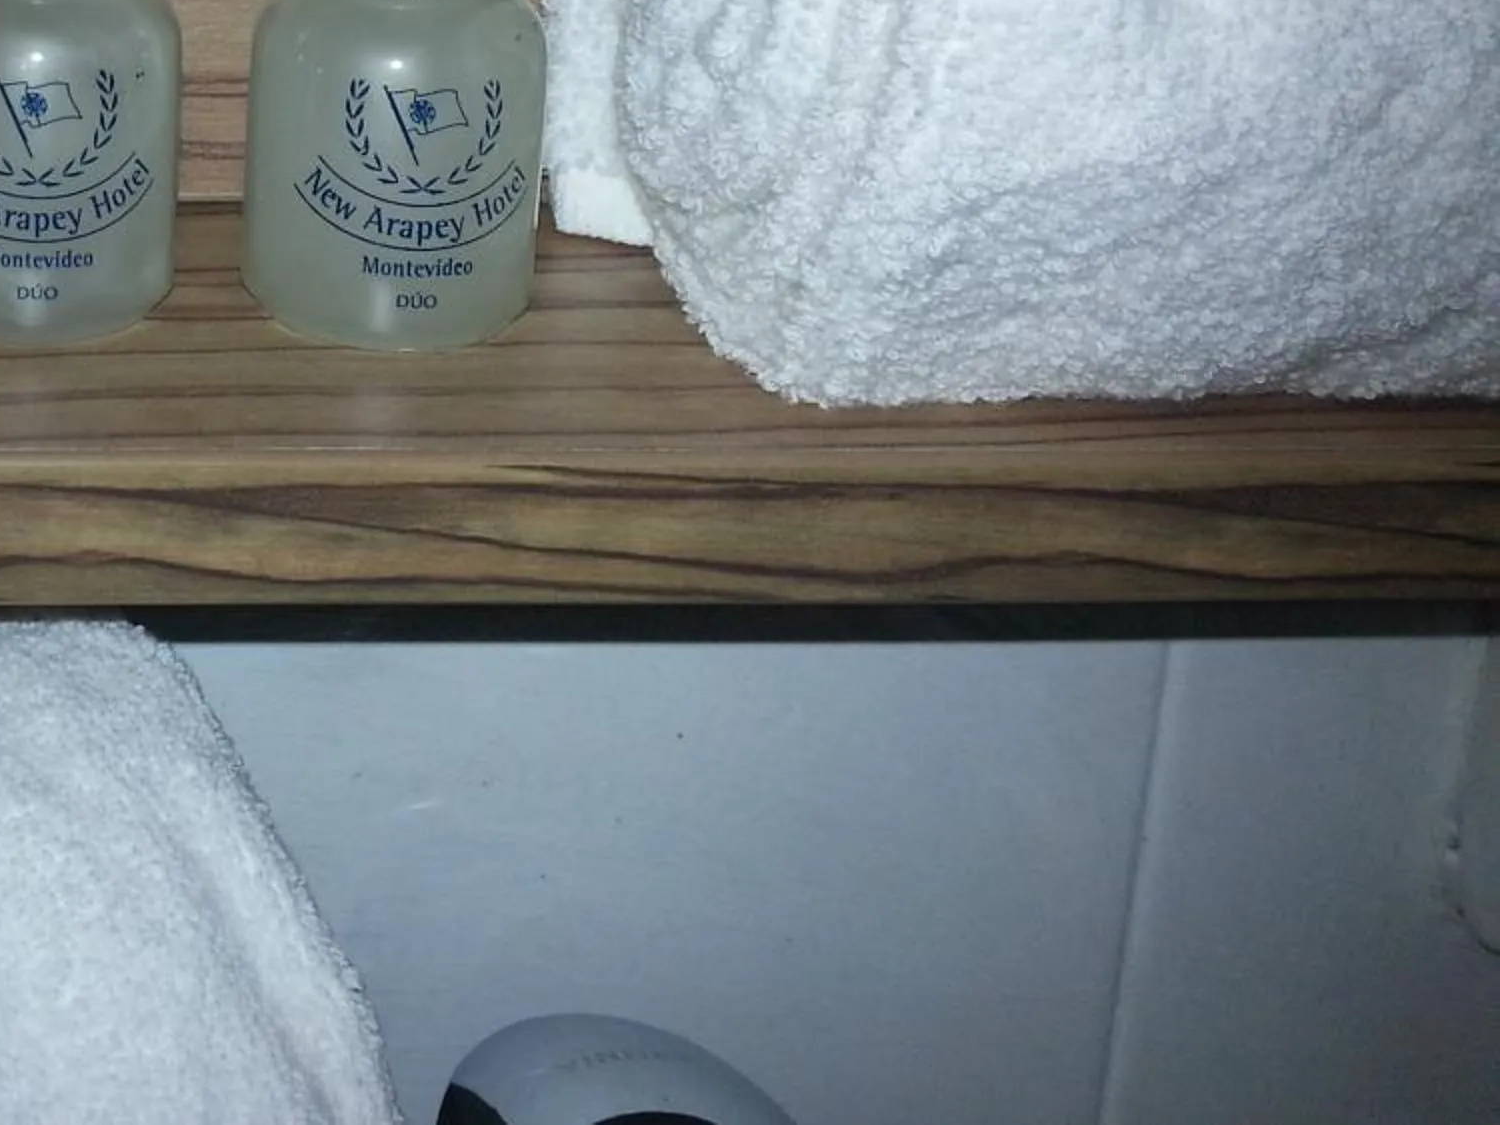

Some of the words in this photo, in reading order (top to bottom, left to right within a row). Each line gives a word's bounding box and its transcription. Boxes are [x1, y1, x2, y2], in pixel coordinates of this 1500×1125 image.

[88, 158, 149, 218] Hotel
[305, 166, 356, 220] New
[364, 205, 465, 246] Arapey
[472, 166, 526, 226] Hotel
[363, 256, 473, 278] Montevideo
